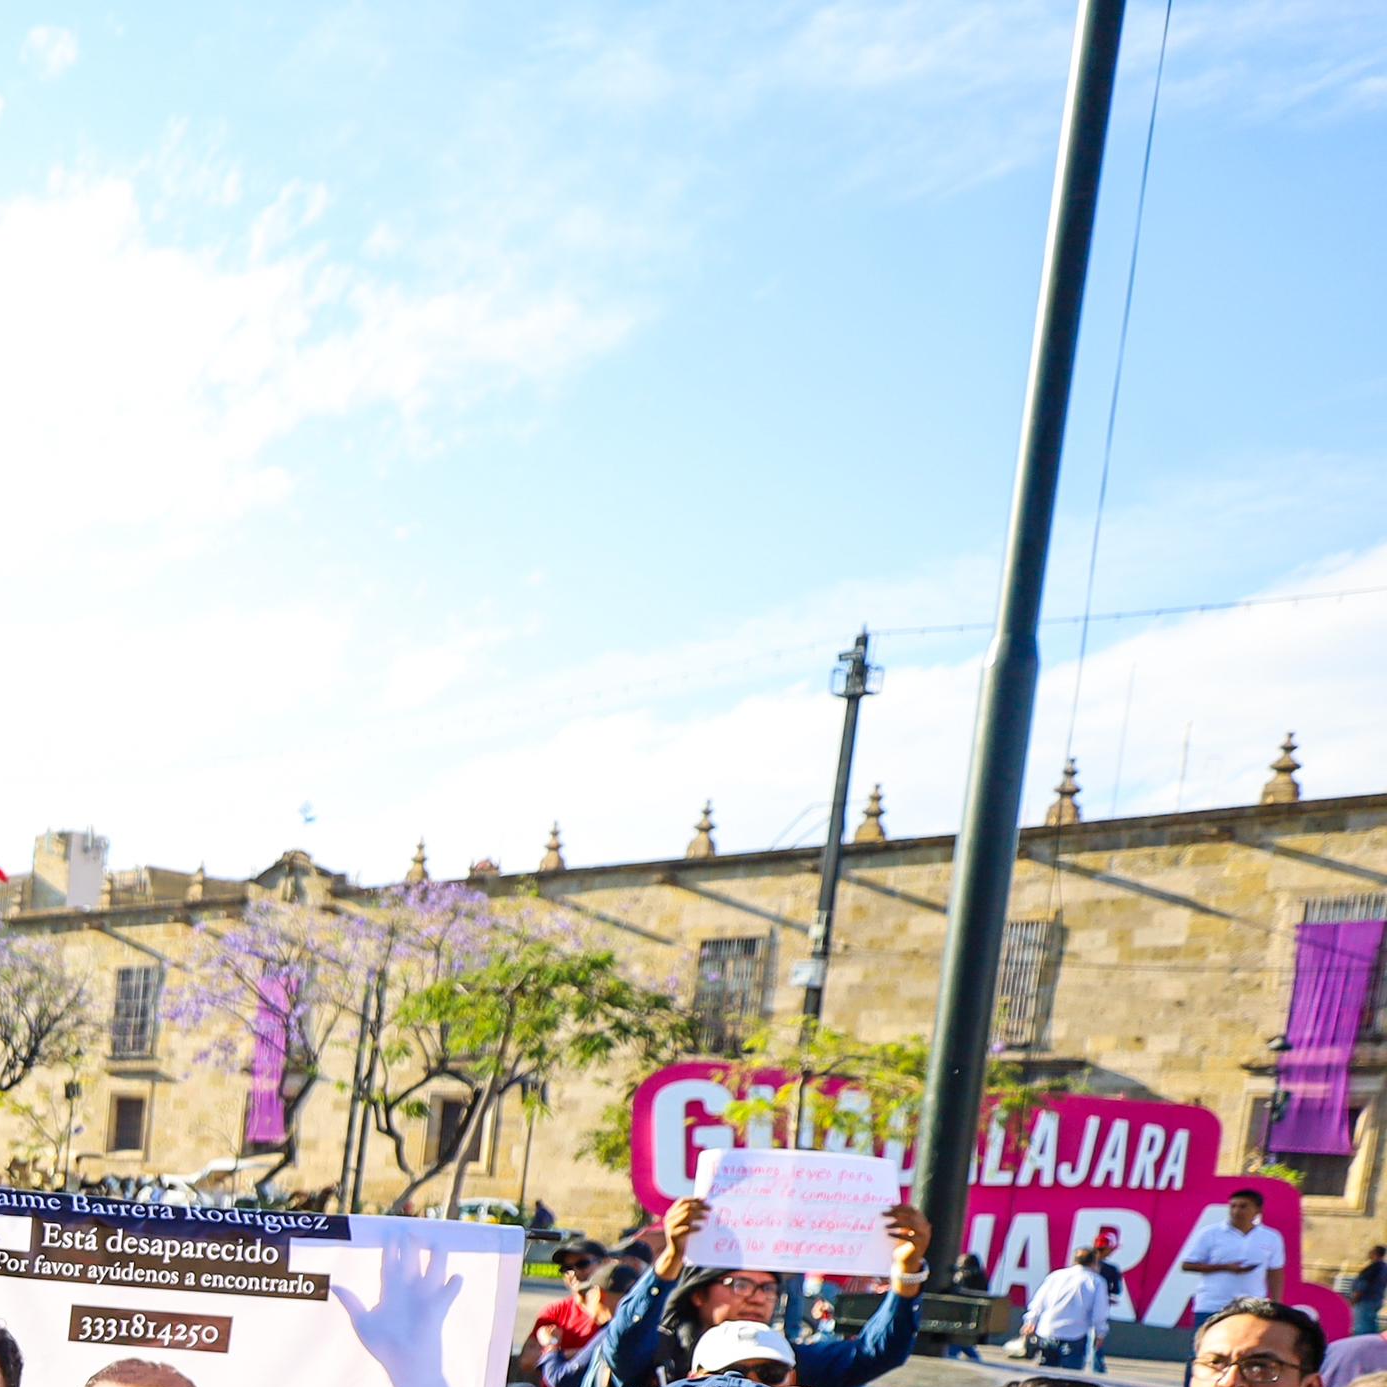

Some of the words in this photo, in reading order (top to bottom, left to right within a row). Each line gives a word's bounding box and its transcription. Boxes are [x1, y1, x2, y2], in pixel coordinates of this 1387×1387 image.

[651, 1079, 1191, 1200] GUADLAJARA
[72, 1193, 176, 1219] Barrera
[185, 1203, 330, 1234] Rodríguez
[41, 1221, 98, 1251] Está
[105, 1227, 279, 1265] desaparecido
[33, 1254, 84, 1277] favor
[87, 1260, 180, 1285] ayúdenos
[184, 1272, 196, 1287] a
[200, 1272, 316, 1296] encontrarlo
[78, 1313, 220, 1349] 3331814250
